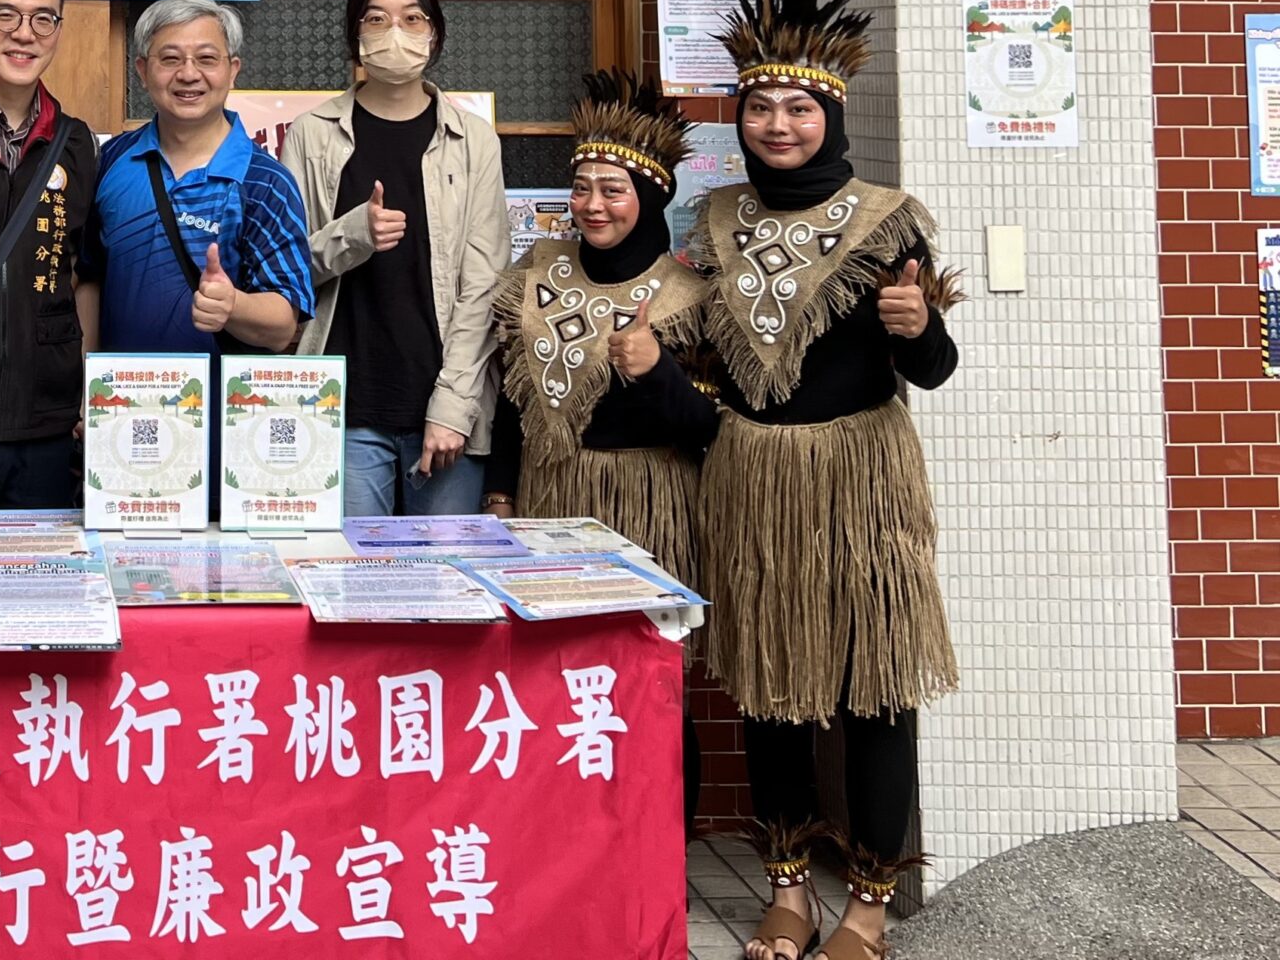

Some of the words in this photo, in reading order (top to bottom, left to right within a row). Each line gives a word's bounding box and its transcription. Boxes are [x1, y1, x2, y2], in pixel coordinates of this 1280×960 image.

[178, 212, 219, 235] JOOLA
[118, 500, 180, 513] 免費換禮物
[255, 500, 317, 513] 免費換禮物
